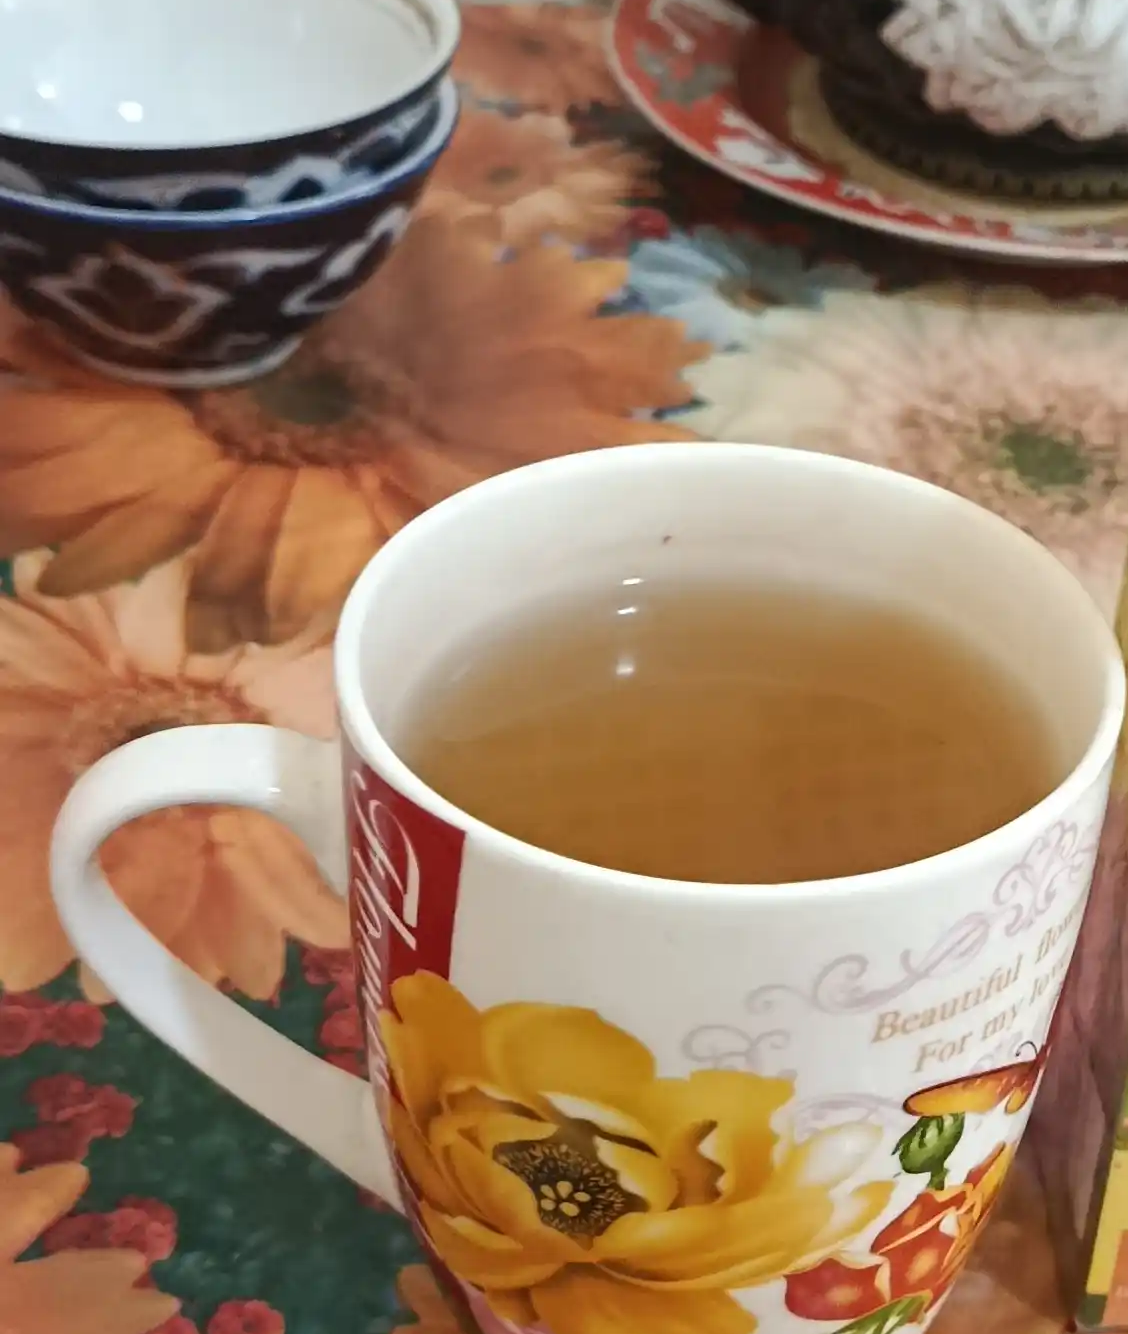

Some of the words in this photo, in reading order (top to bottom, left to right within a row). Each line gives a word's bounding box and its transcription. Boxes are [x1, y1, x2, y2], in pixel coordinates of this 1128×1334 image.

[870, 952, 1024, 1044] Beautiful
[912, 1030, 973, 1074] For
[980, 997, 1024, 1041] my
